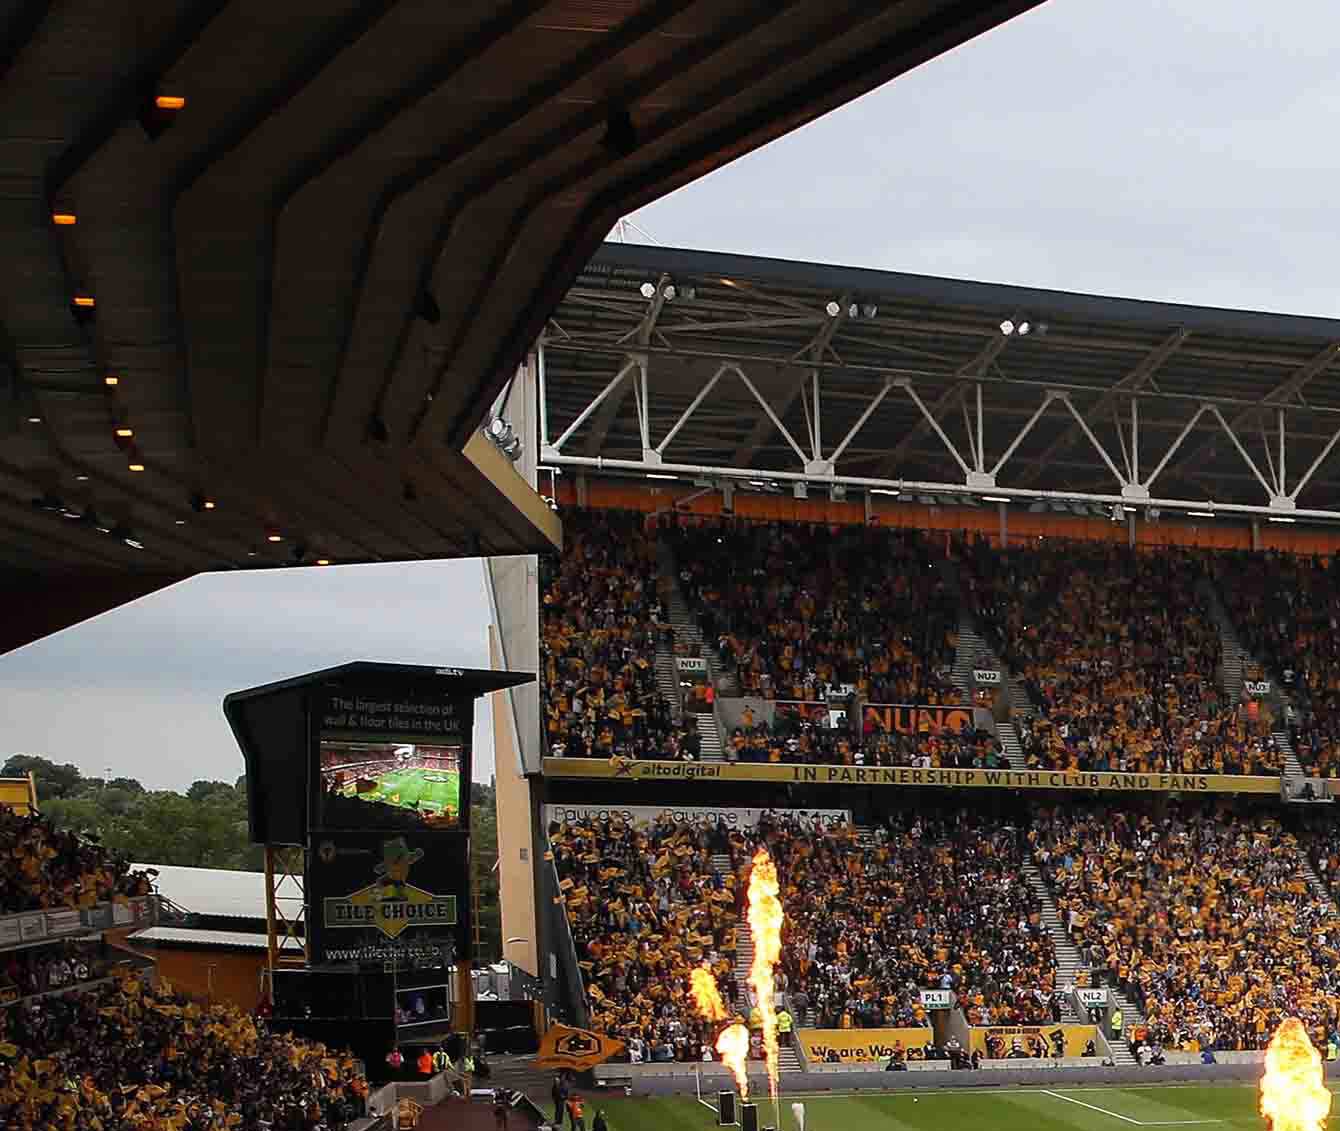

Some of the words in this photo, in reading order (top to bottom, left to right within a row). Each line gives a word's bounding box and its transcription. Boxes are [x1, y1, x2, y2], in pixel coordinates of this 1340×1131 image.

[681, 660, 702, 669] NU1
[977, 672, 997, 680] NU2
[641, 763, 721, 779] altodigital
[795, 766, 817, 781] IN
[829, 768, 975, 784] PARTNERSHIP
[985, 771, 1040, 786] WITH
[1050, 773, 1099, 788] CLUB
[1111, 775, 1150, 788] AND
[1160, 777, 1208, 790] FANS
[335, 904, 375, 920] TILE
[382, 902, 448, 919] CHOICE
[925, 994, 943, 1002] PL1
[1083, 992, 1102, 1000] NL2
[811, 1045, 838, 1059] We
[840, 1049, 863, 1059] are
[869, 1046, 923, 1059] Woes
